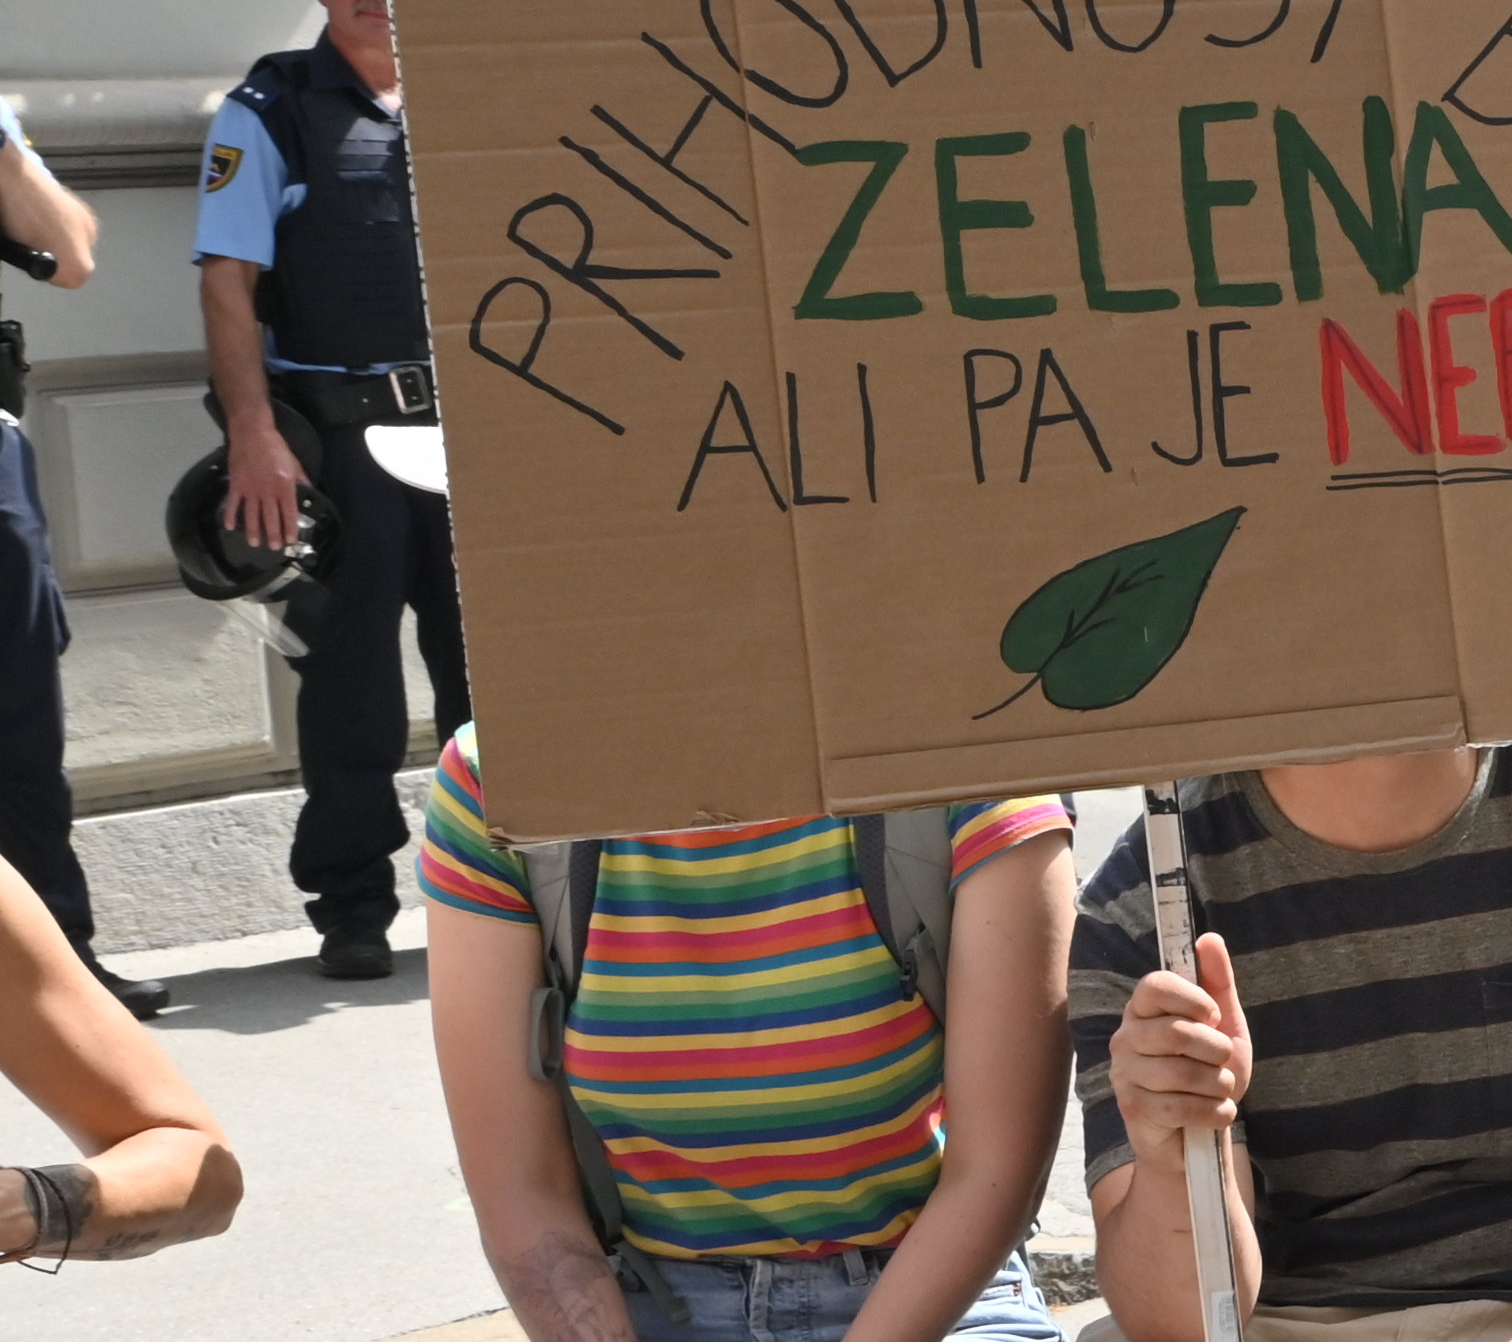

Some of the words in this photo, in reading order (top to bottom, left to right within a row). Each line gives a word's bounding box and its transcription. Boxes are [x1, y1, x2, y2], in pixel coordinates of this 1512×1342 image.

[677, 363, 877, 512] ALI
[965, 346, 1112, 484] PA
[1151, 321, 1280, 468] JE
